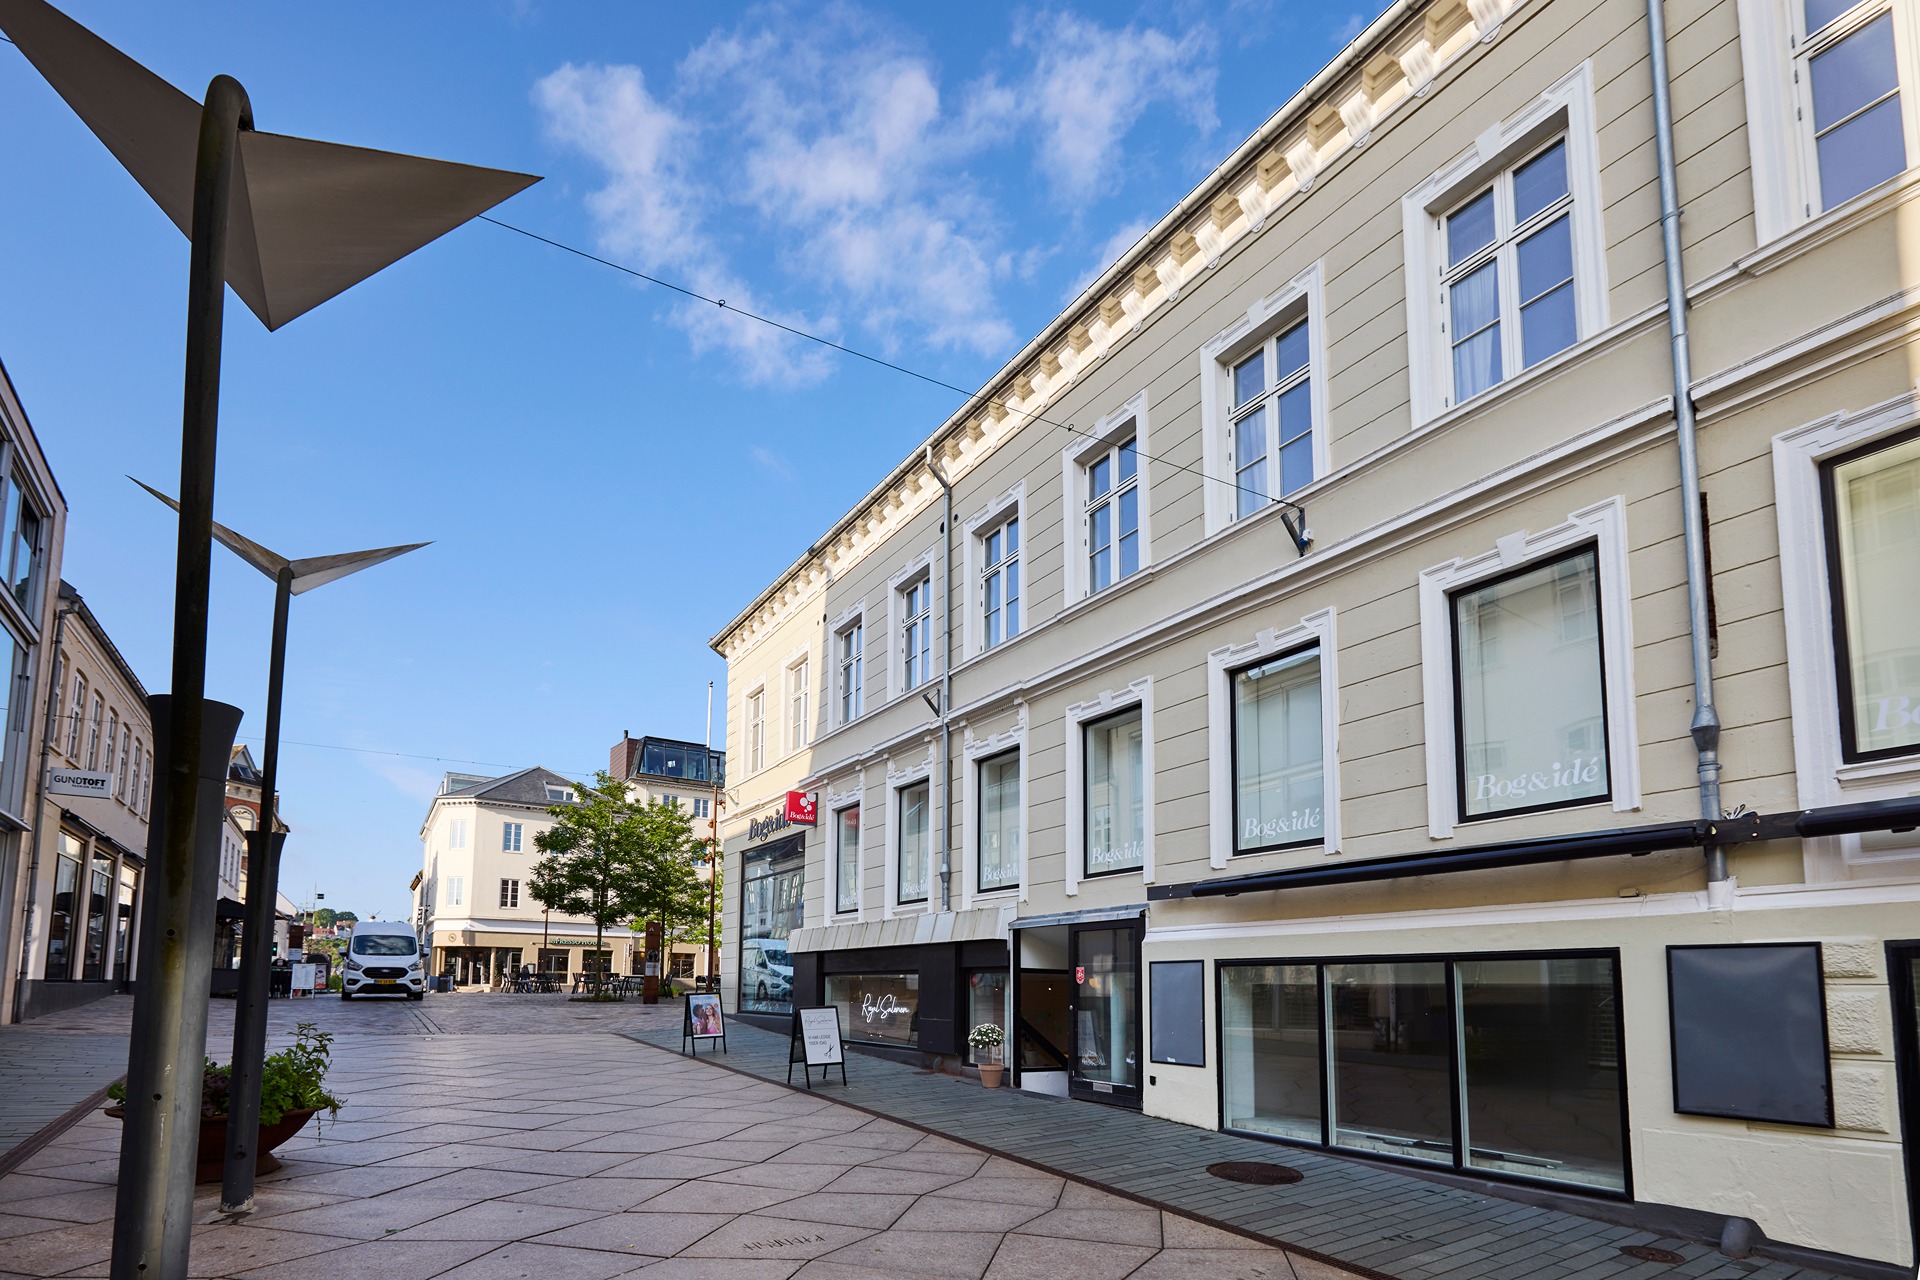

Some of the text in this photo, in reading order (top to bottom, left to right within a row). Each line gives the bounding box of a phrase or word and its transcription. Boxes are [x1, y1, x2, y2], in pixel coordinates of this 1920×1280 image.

[1870, 696, 1920, 732] B
[54, 775, 106, 786] GUNDTOFT
[1474, 756, 1599, 800] Bog&idé
[1242, 808, 1320, 839] Bog&idé
[1090, 840, 1144, 865] Bog&idé
